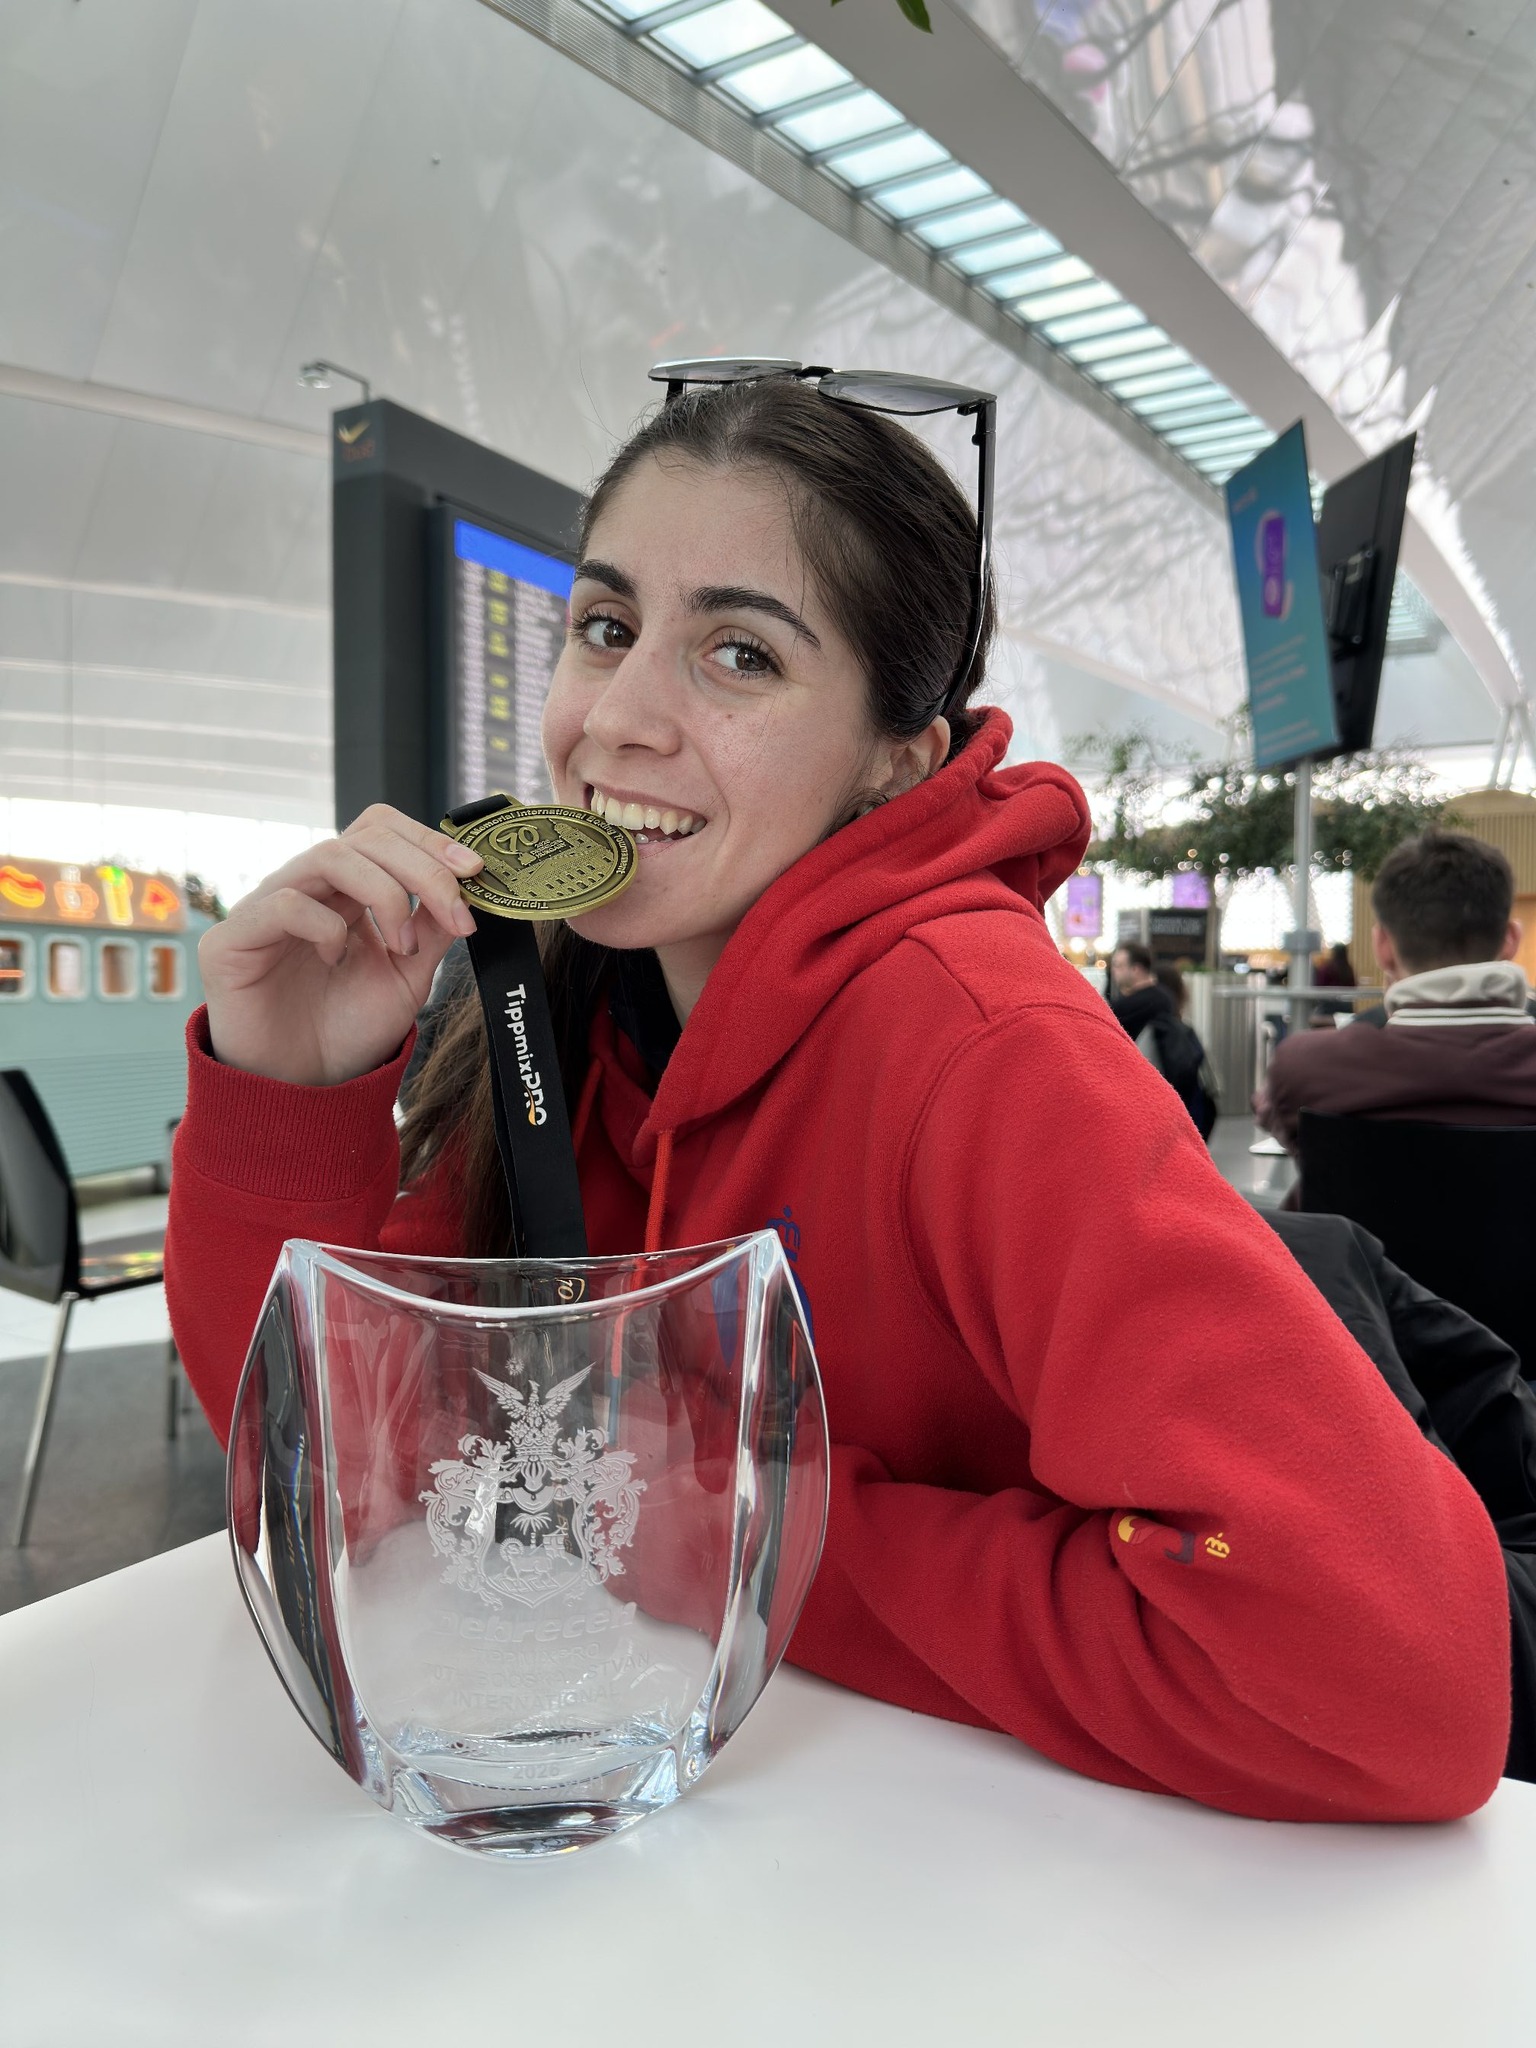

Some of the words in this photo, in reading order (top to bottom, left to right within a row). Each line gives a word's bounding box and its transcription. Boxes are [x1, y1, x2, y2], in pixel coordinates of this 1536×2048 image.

[472, 812, 515, 836] Memorial
[516, 808, 587, 820] International
[585, 815, 616, 835] Boxing
[495, 826, 540, 853] 70
[484, 892, 549, 909] TippmixPro
[434, 1602, 637, 1643] Debrecen
[513, 1764, 560, 1780] 2026
